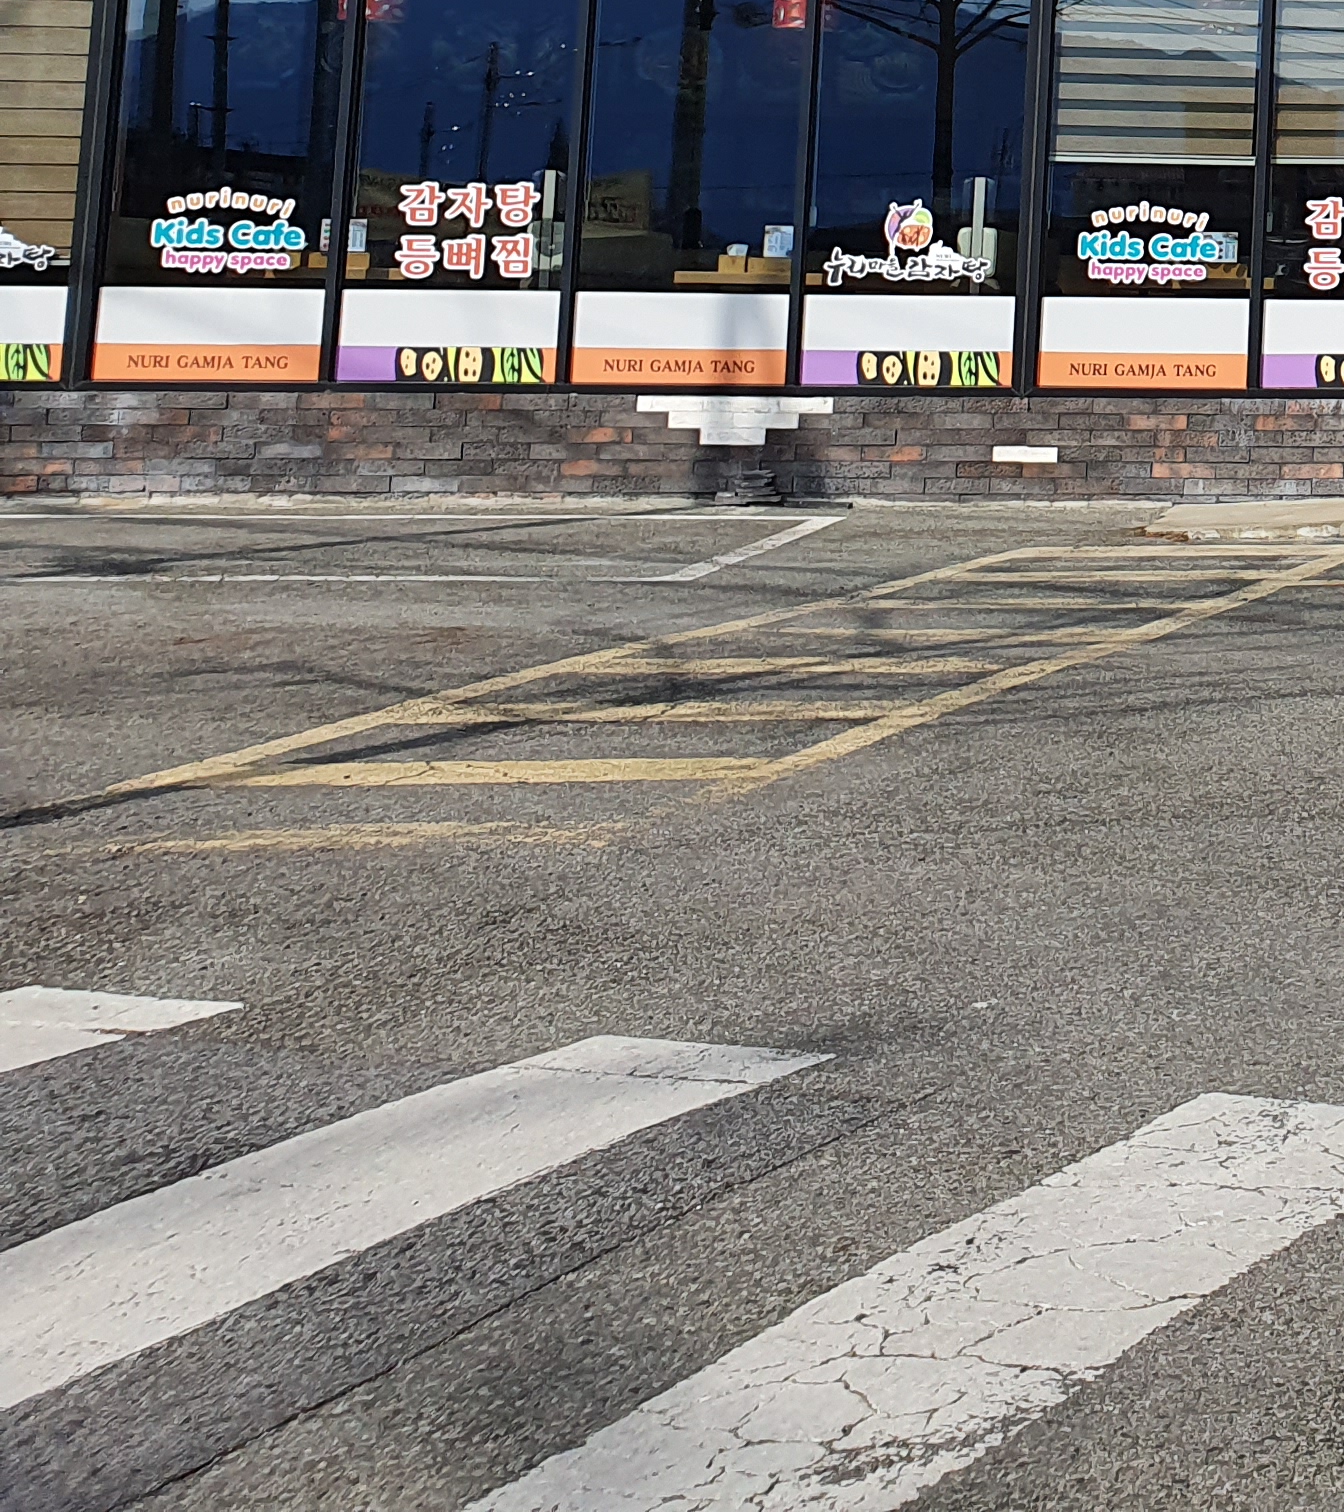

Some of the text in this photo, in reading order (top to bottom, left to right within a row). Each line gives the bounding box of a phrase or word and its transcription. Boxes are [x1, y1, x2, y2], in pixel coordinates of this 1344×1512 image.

[168, 189, 295, 218] nurinuri
[400, 183, 539, 226] 감자탕
[1092, 202, 1209, 230] nurinuri
[152, 220, 306, 248] Kids Cafe
[1080, 232, 1218, 259] Kids Cafe
[163, 249, 290, 271] happy space
[397, 235, 533, 277] 등뼈찜
[1090, 261, 1205, 282] happy space
[126, 354, 289, 372] NURI GAMJA TANG
[602, 358, 756, 376] NURI GAMJA TANG
[1068, 362, 1217, 379] NURI GAMJA TANG
